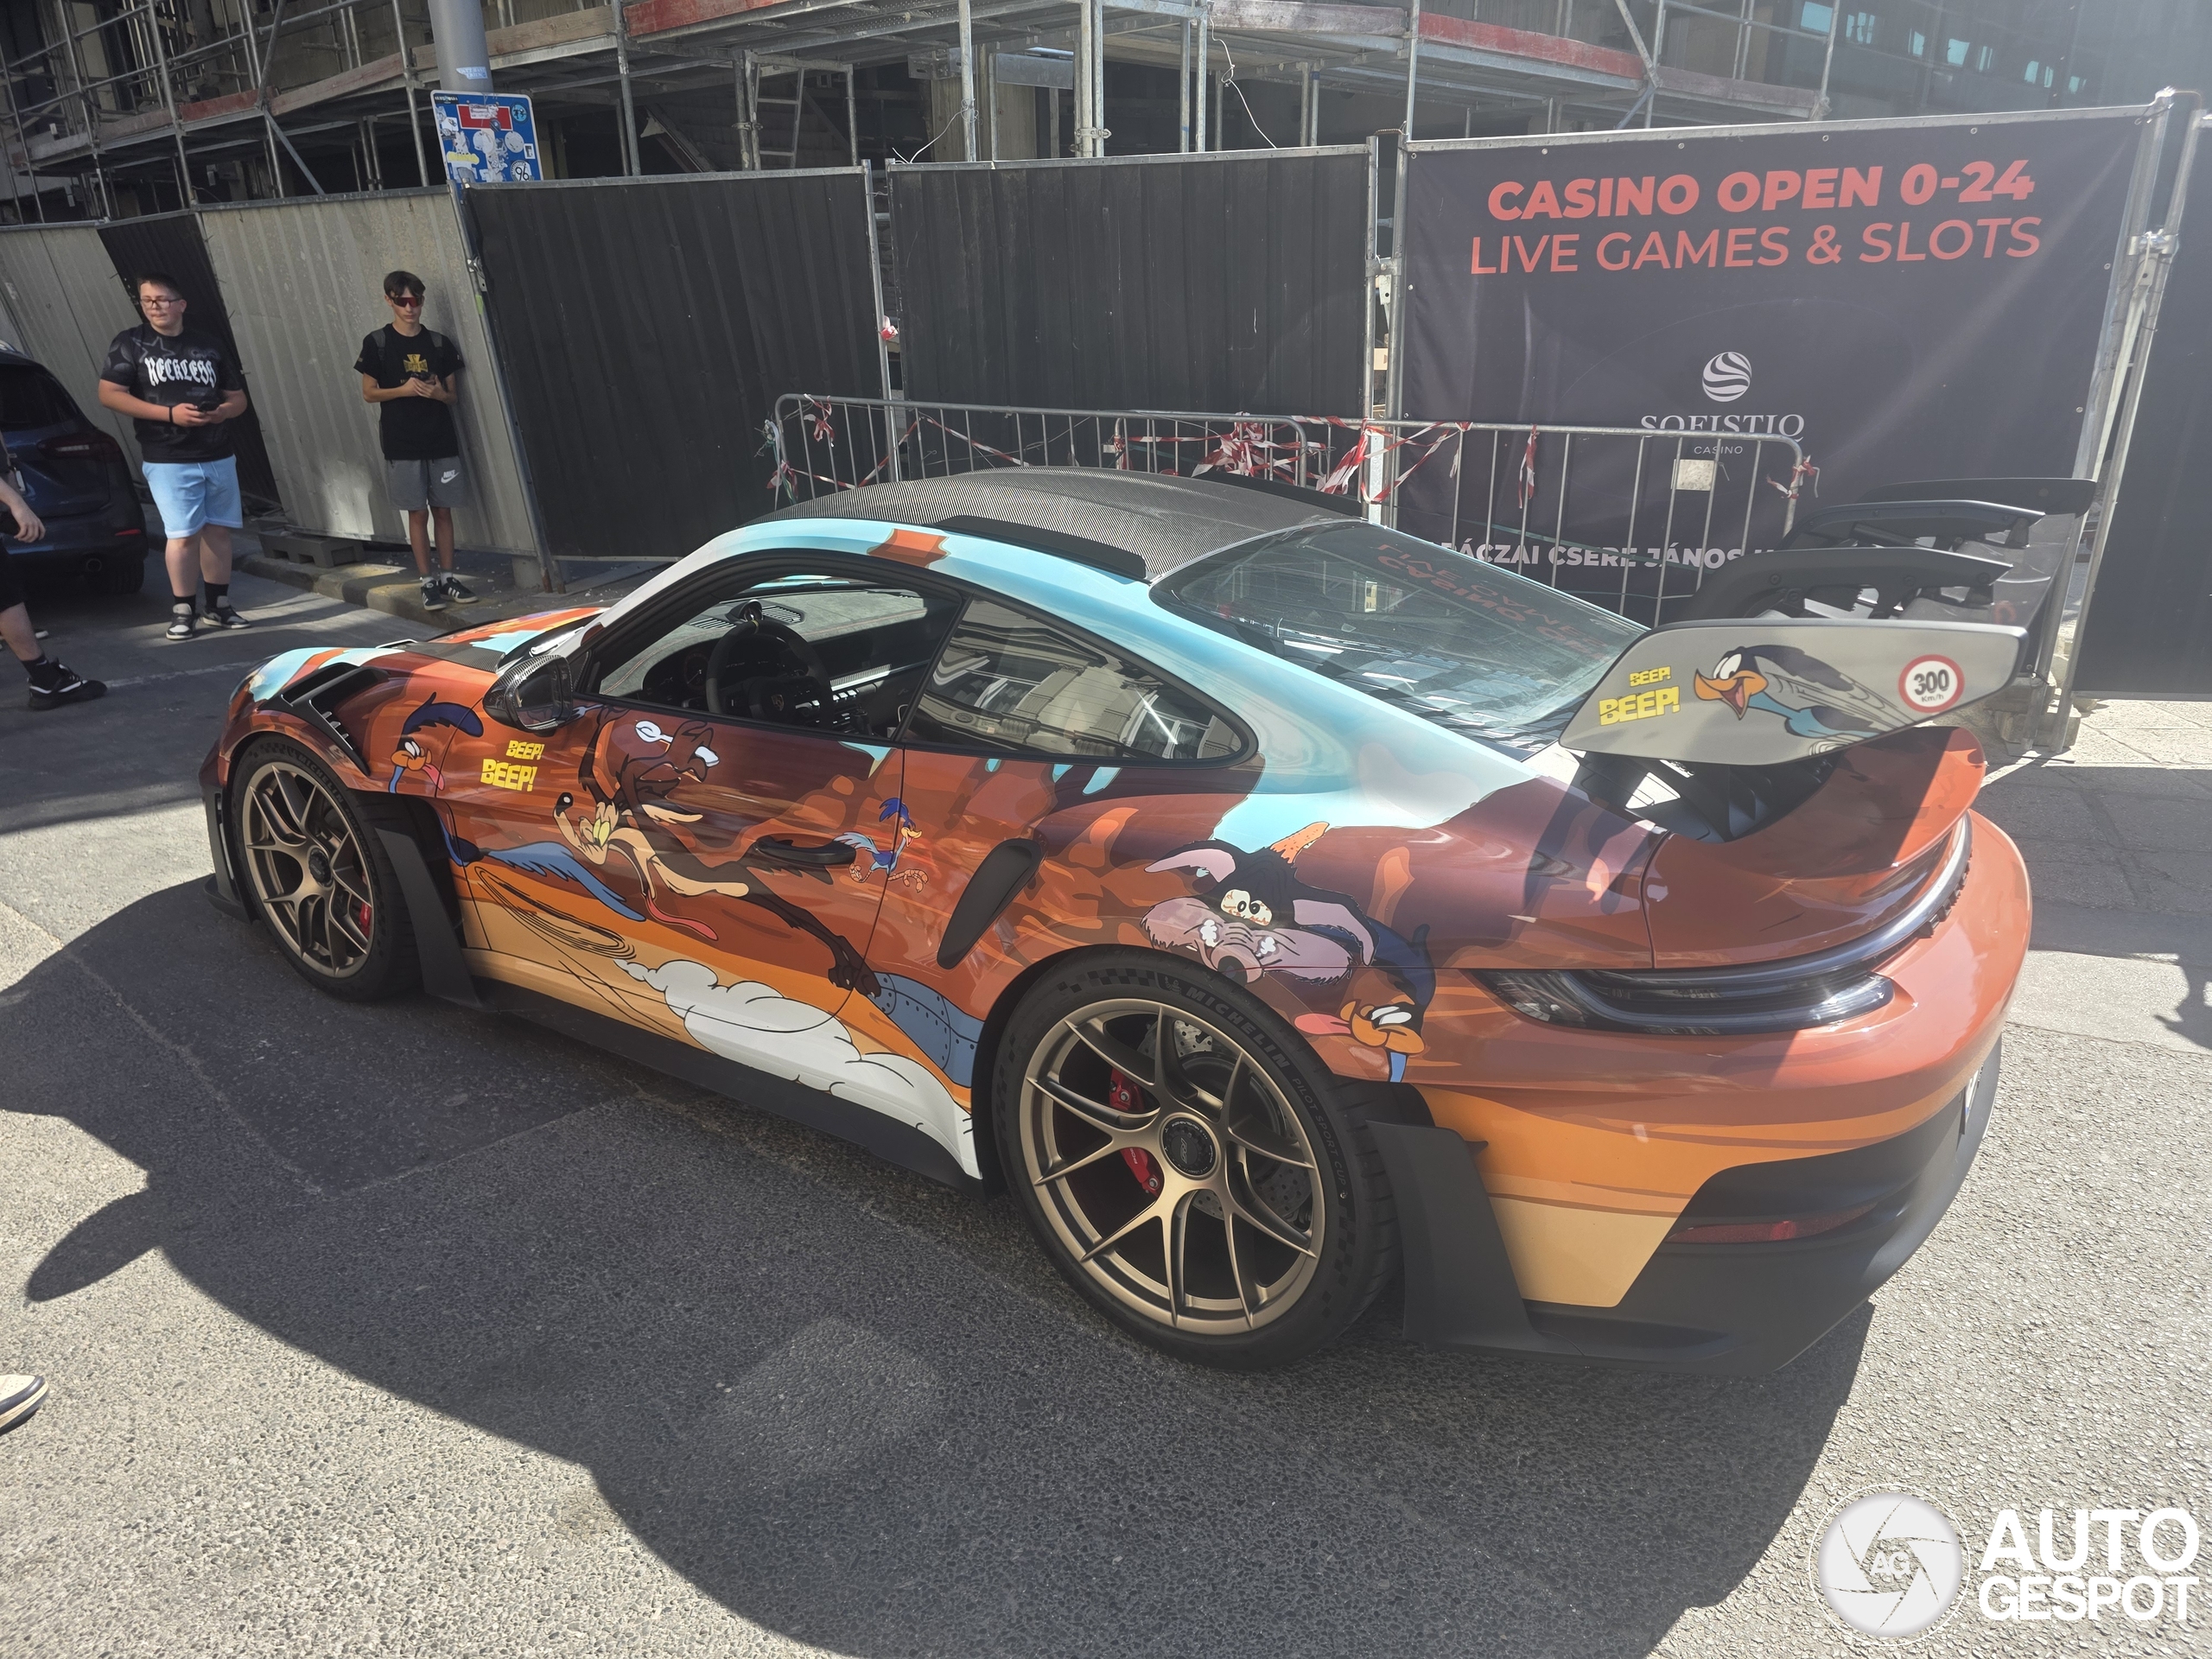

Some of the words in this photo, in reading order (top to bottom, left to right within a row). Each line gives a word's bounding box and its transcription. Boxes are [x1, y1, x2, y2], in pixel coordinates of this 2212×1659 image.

[1488, 172, 1700, 220] CASINO
[1717, 166, 1883, 213] OPEN
[1901, 160, 2035, 207] 0-24
[1471, 234, 1580, 275] LIVE
[1597, 226, 1789, 272] GAMES
[1807, 224, 1841, 264] &
[1860, 216, 2040, 264] SLOTS
[1694, 446, 1744, 454] CASINO
[1440, 537, 1539, 565] ÁCZAI
[1548, 545, 1637, 568] CSERE
[1630, 666, 1671, 687] BEEP!
[1913, 669, 1950, 696] 300
[1599, 686, 1680, 726] BEEP!
[505, 740, 545, 760] BEEP!
[298, 753, 344, 804] MICHELIN
[480, 758, 538, 792] BEEP!
[1185, 987, 1291, 1070] MICHELIN
[1292, 1077, 1319, 1111] PILOT
[1315, 1115, 1339, 1154] SPORT
[1334, 1160, 1348, 1187] CUP
